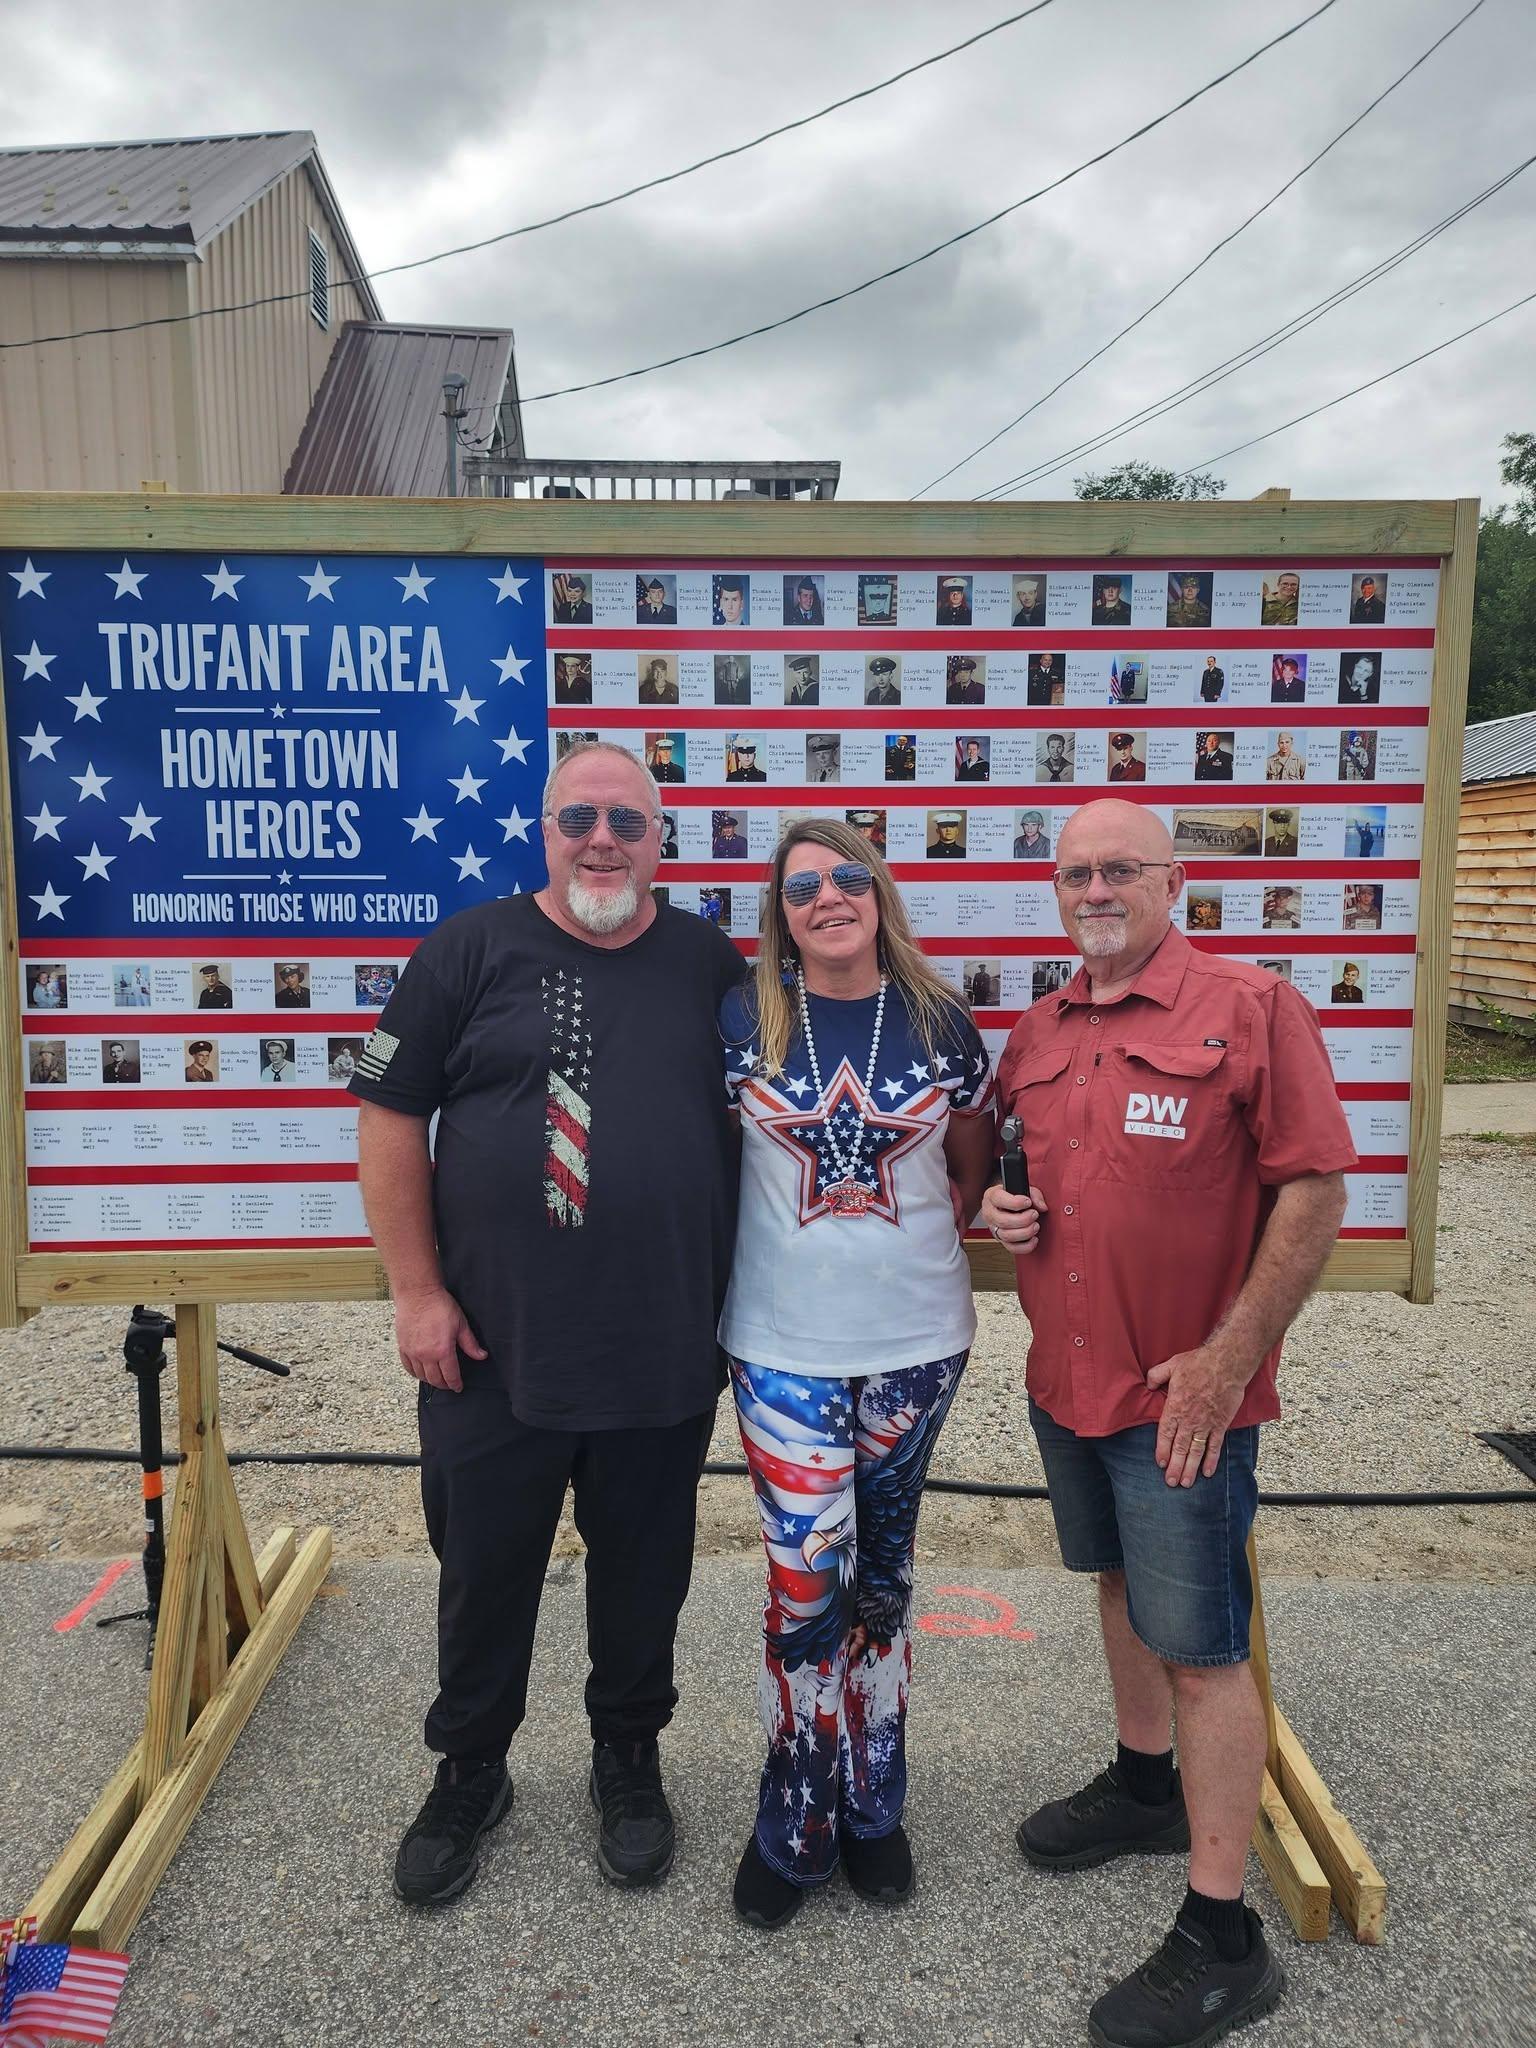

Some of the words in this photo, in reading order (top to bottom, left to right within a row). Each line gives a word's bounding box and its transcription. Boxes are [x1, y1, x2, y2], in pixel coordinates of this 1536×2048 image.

[98, 622, 310, 691] TRUFANT
[326, 624, 450, 693] AREA
[160, 728, 399, 789] HOMETOWN
[205, 799, 362, 859] HEROES
[132, 892, 234, 923] HONORING
[239, 893, 303, 922] THOSE
[310, 893, 358, 922] WHO
[363, 893, 438, 923] SERVED
[1125, 1093, 1189, 1125] DW
[1129, 1125, 1181, 1137] VIDEO
